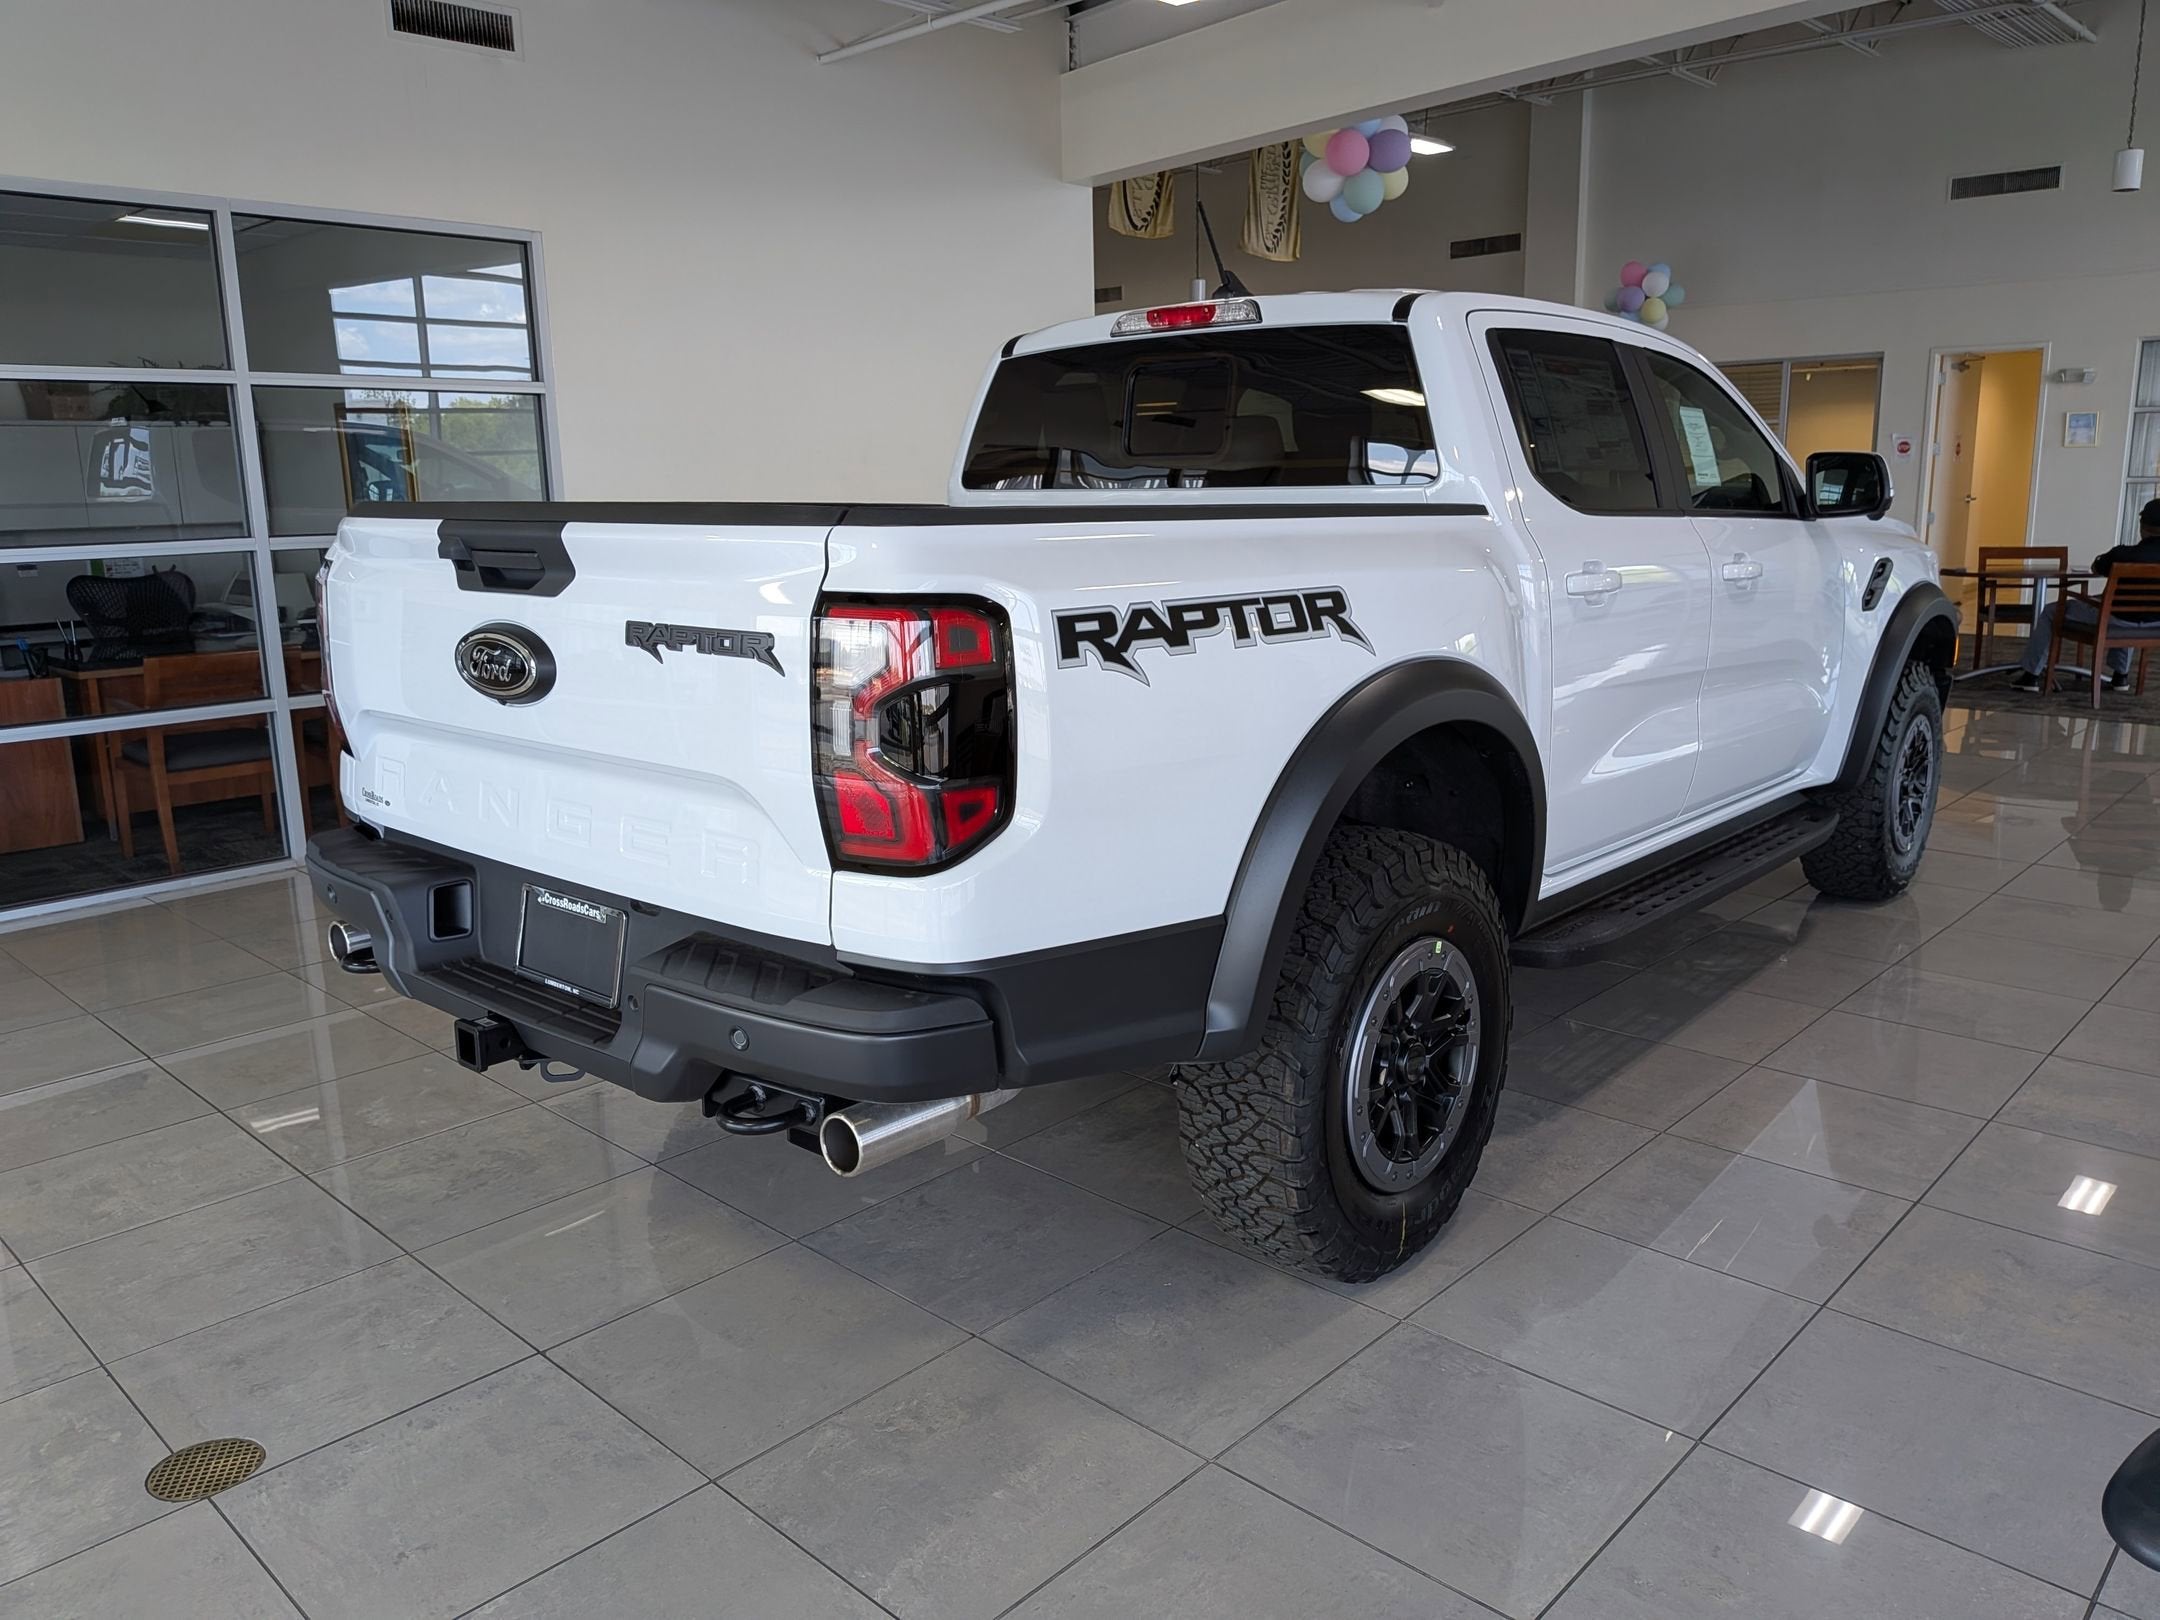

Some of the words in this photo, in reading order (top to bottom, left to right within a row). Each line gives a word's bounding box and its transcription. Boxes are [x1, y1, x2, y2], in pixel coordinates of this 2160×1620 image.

[469, 647, 512, 683] Ford
[625, 620, 786, 677] RAPTOR
[1051, 585, 1376, 687] RAPTOR
[373, 754, 761, 885] RANGER
